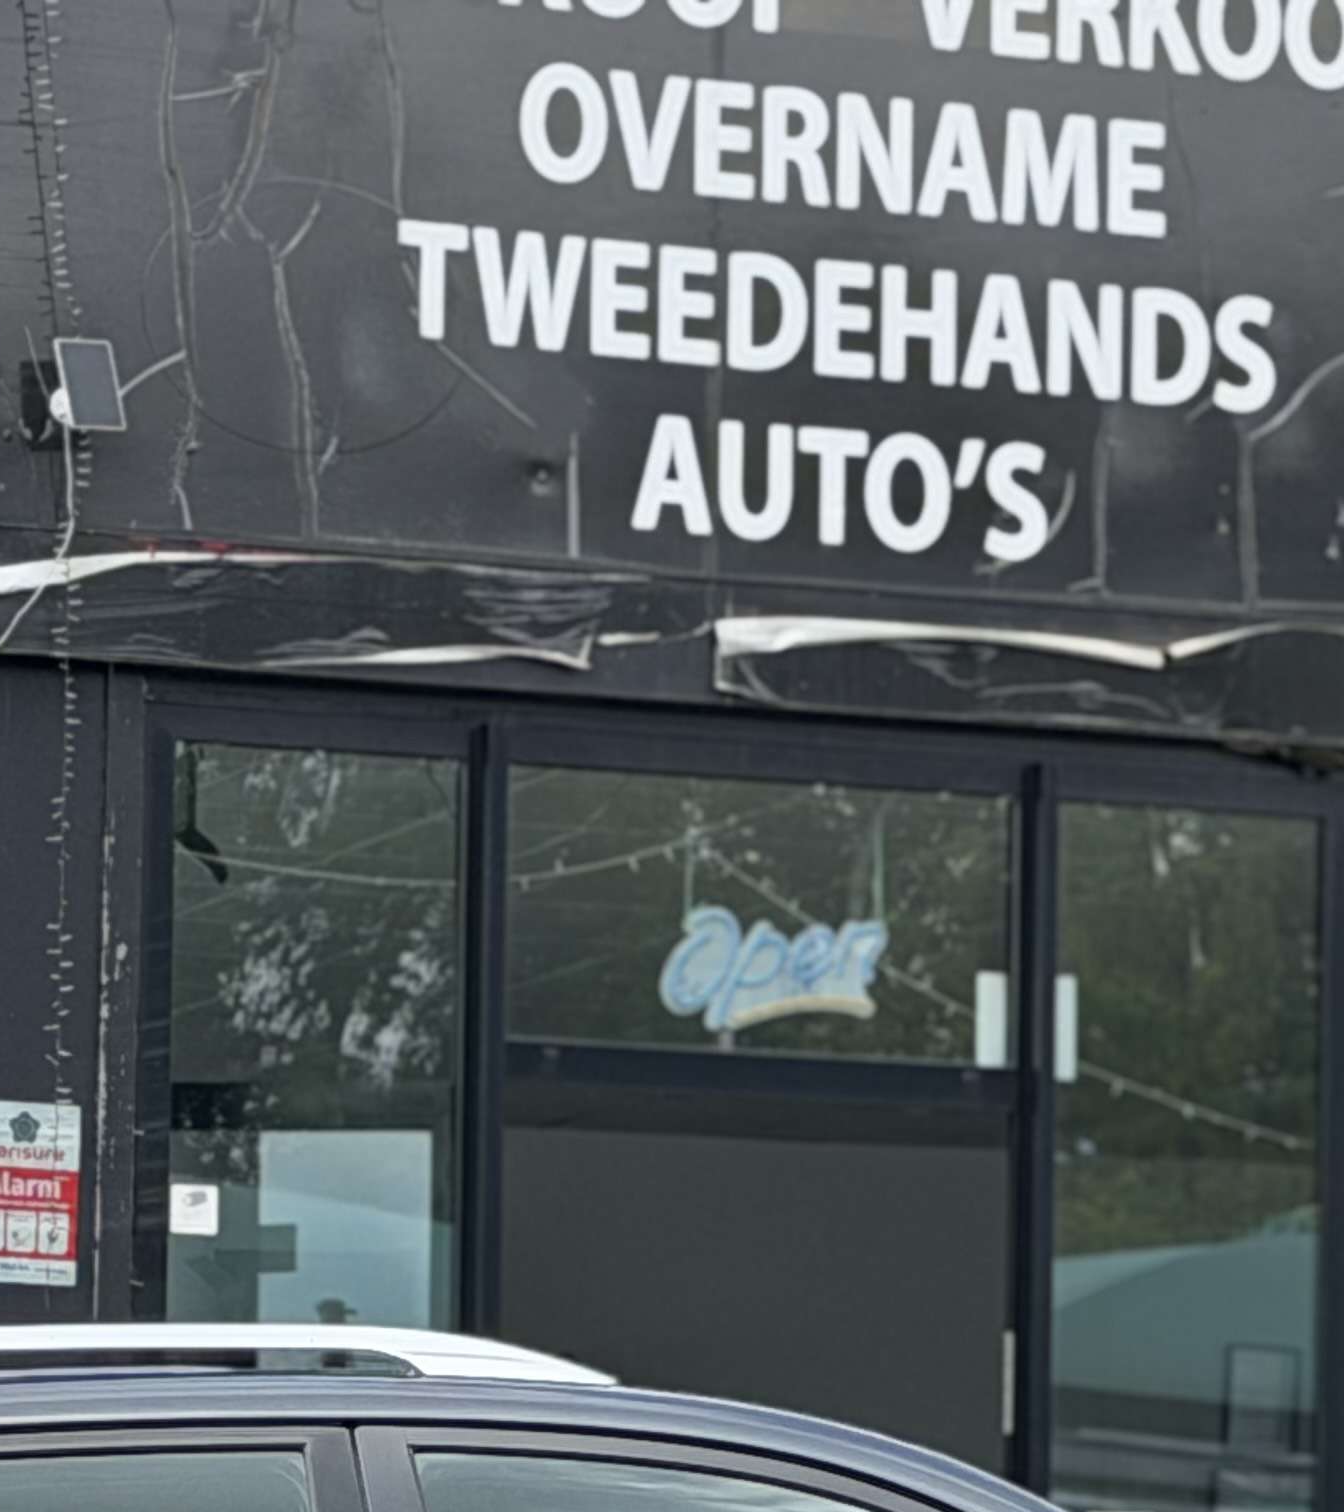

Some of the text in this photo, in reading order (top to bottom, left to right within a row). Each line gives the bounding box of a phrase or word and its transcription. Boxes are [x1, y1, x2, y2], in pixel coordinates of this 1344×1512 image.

[519, 62, 1167, 238] OVERNAME
[397, 218, 1278, 415] TWEEDEHANDS
[631, 413, 1049, 562] AUTO'S
[660, 906, 887, 1029] Open
